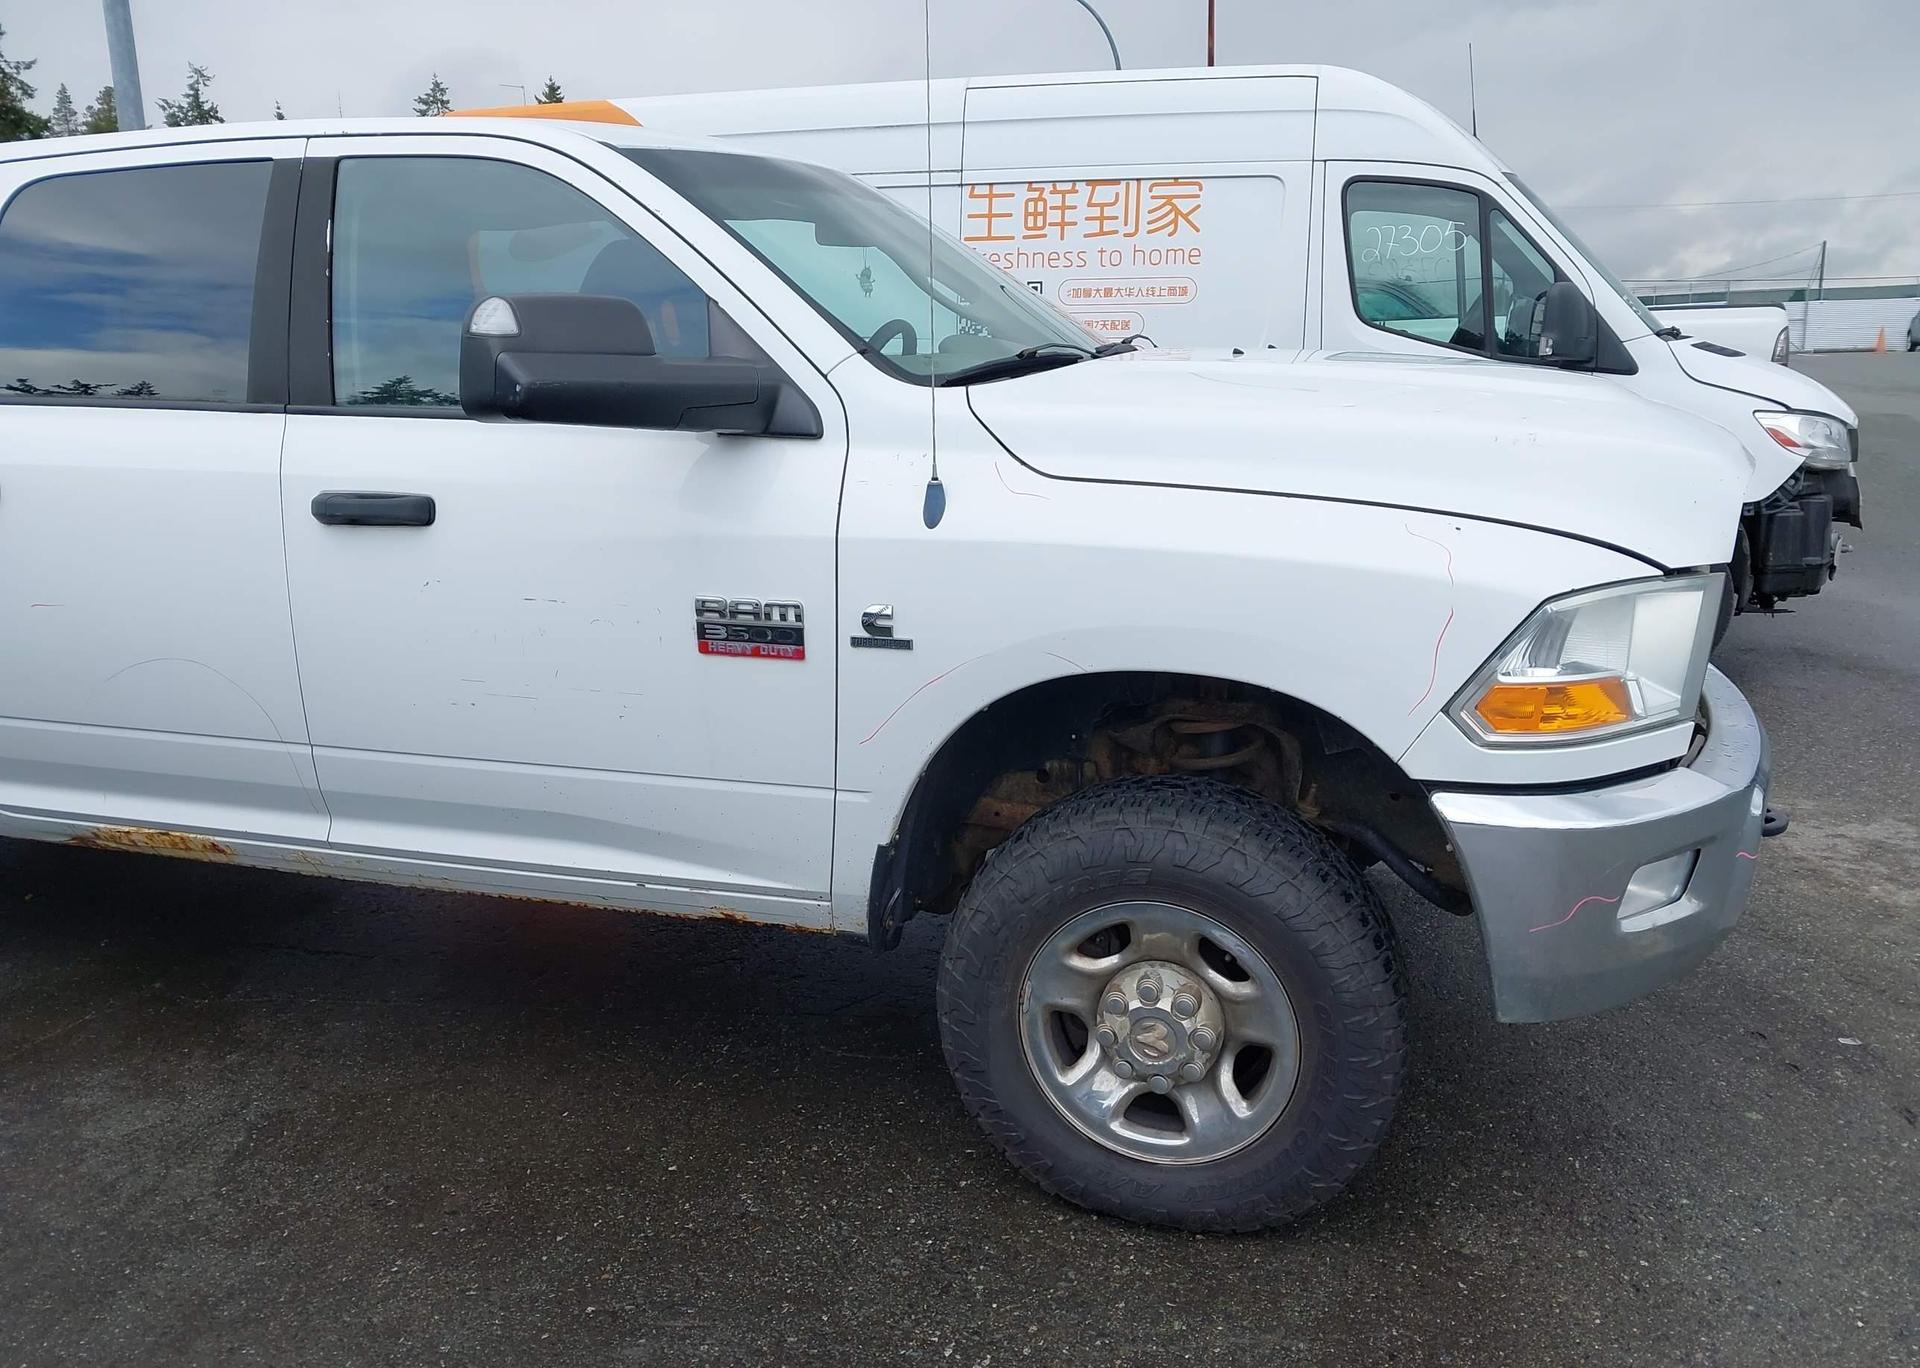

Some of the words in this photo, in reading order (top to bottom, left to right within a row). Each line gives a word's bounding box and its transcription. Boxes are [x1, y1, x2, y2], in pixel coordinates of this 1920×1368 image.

[964, 177, 1204, 242] 生鲜到家
[1361, 221, 1467, 262] 27305
[972, 247, 1087, 270] eshness
[1099, 247, 1123, 267] to
[1132, 244, 1201, 267] home
[695, 594, 805, 623] RAM
[704, 623, 796, 643] 3500
[708, 641, 753, 654] HEAVY
[758, 644, 796, 657] DUTY
